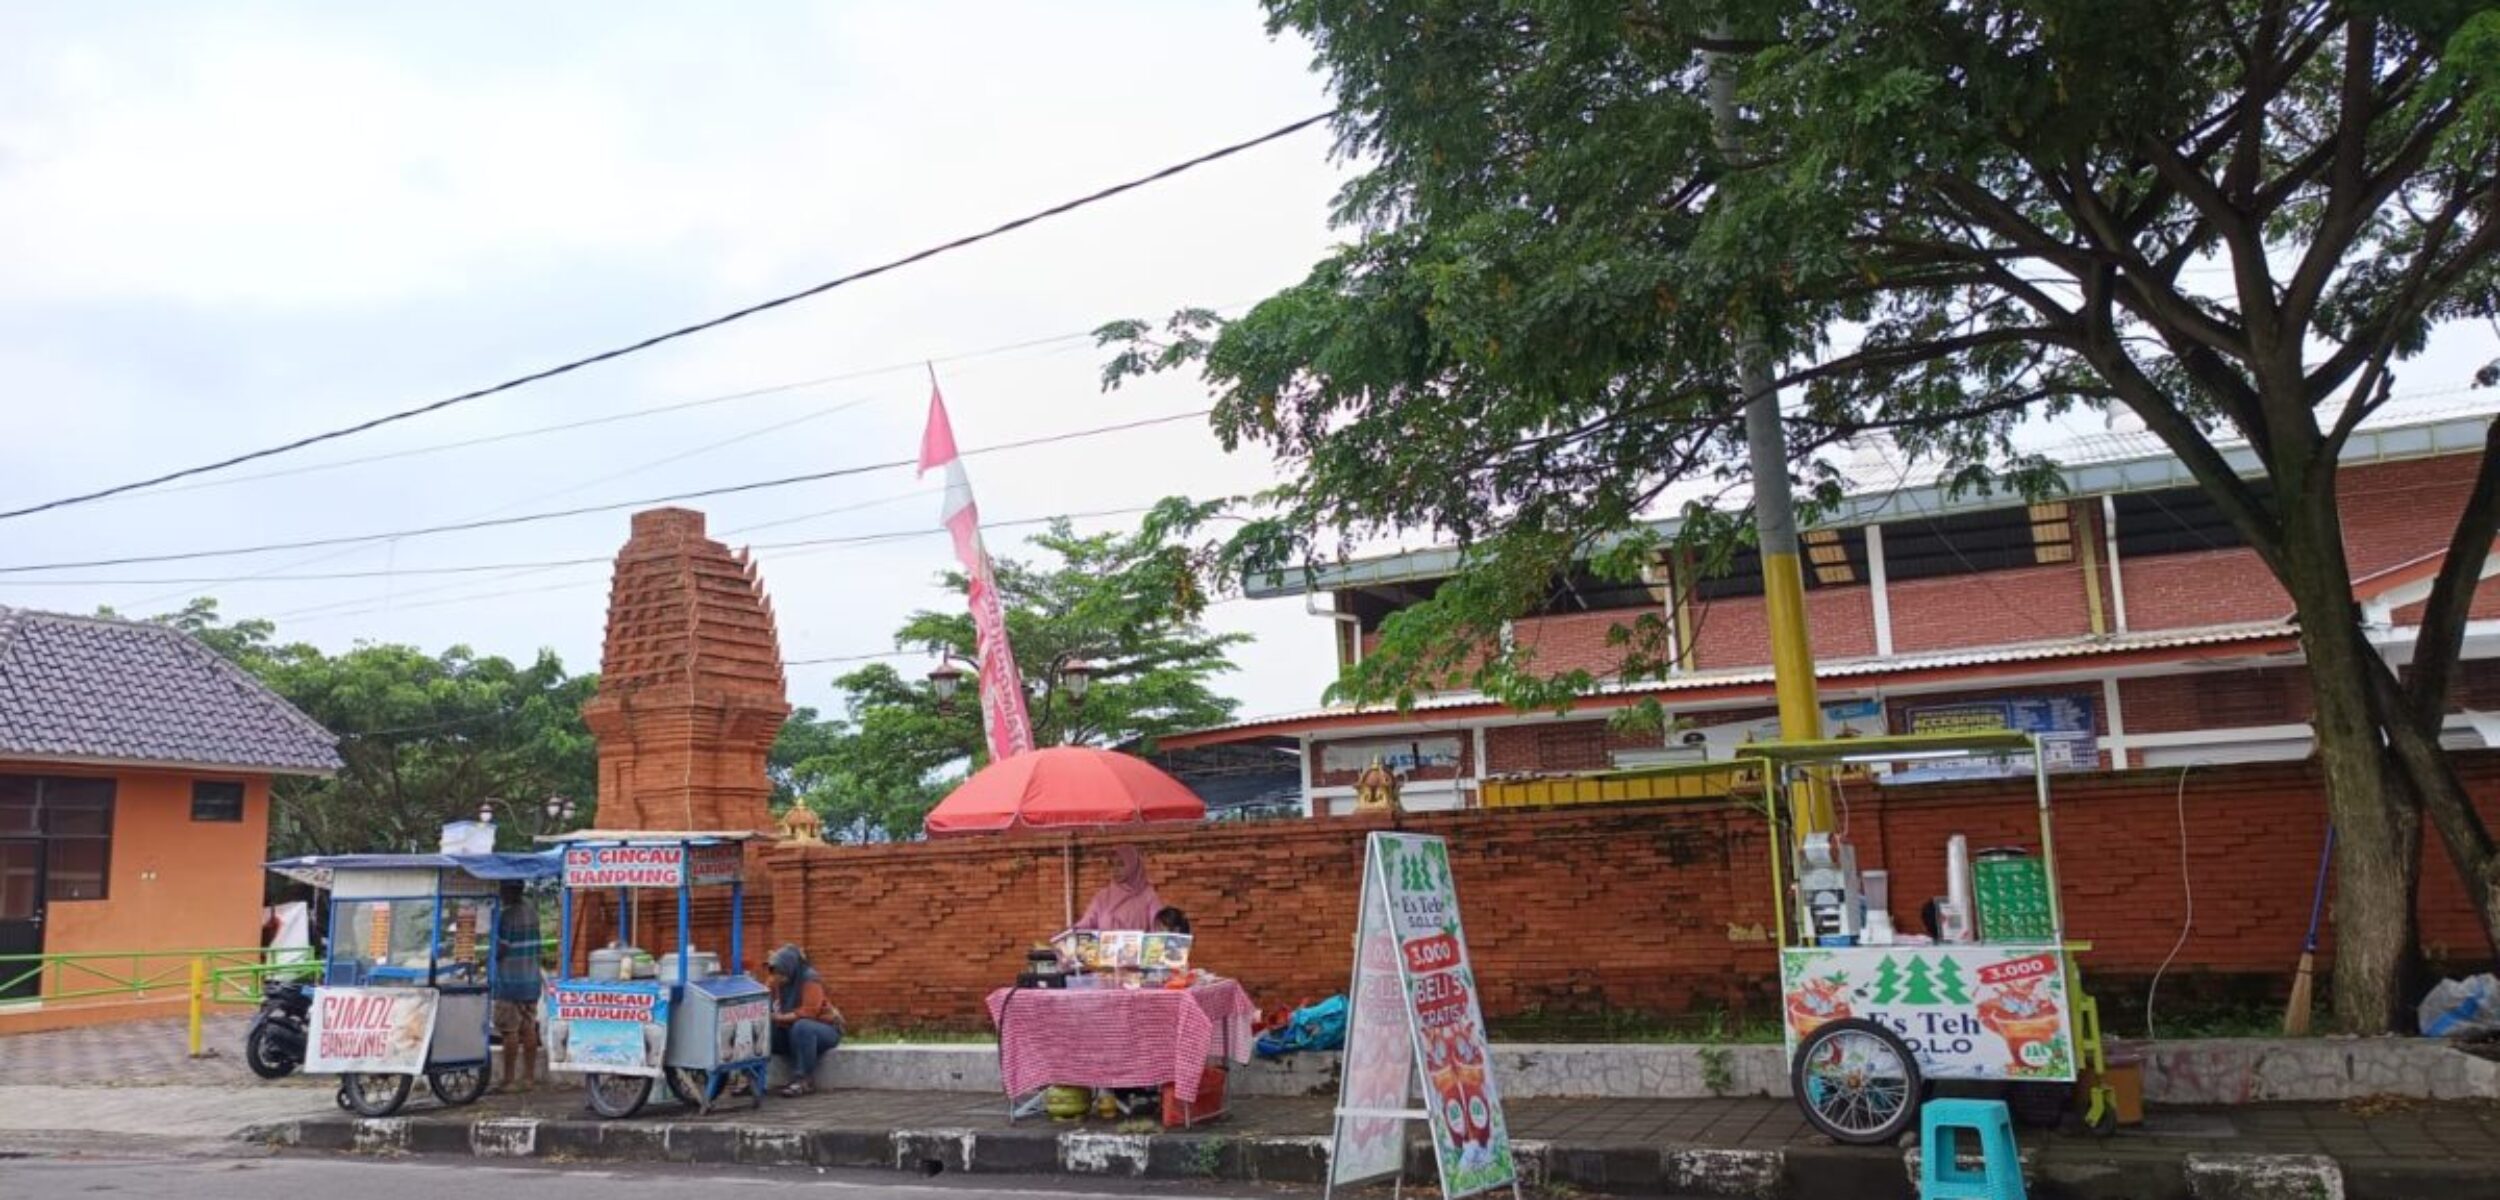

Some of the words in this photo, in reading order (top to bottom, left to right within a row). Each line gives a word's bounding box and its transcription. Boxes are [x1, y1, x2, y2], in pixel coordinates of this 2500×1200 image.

[568, 850, 592, 865] ES
[598, 849, 682, 865] CINCAU
[570, 869, 678, 884] BANDUNG
[1402, 897, 1418, 913] Es
[1411, 943, 1451, 965] 3.000
[1991, 959, 2045, 980] 3.000
[559, 992, 581, 1005] ES
[585, 992, 653, 1006] CINCAU
[1416, 975, 1449, 1004] BELI
[322, 996, 394, 1030] CIMOL
[560, 1007, 649, 1021] BANDUNG
[1917, 1011, 1981, 1035] Teh
[320, 1031, 389, 1060] BANDUNG
